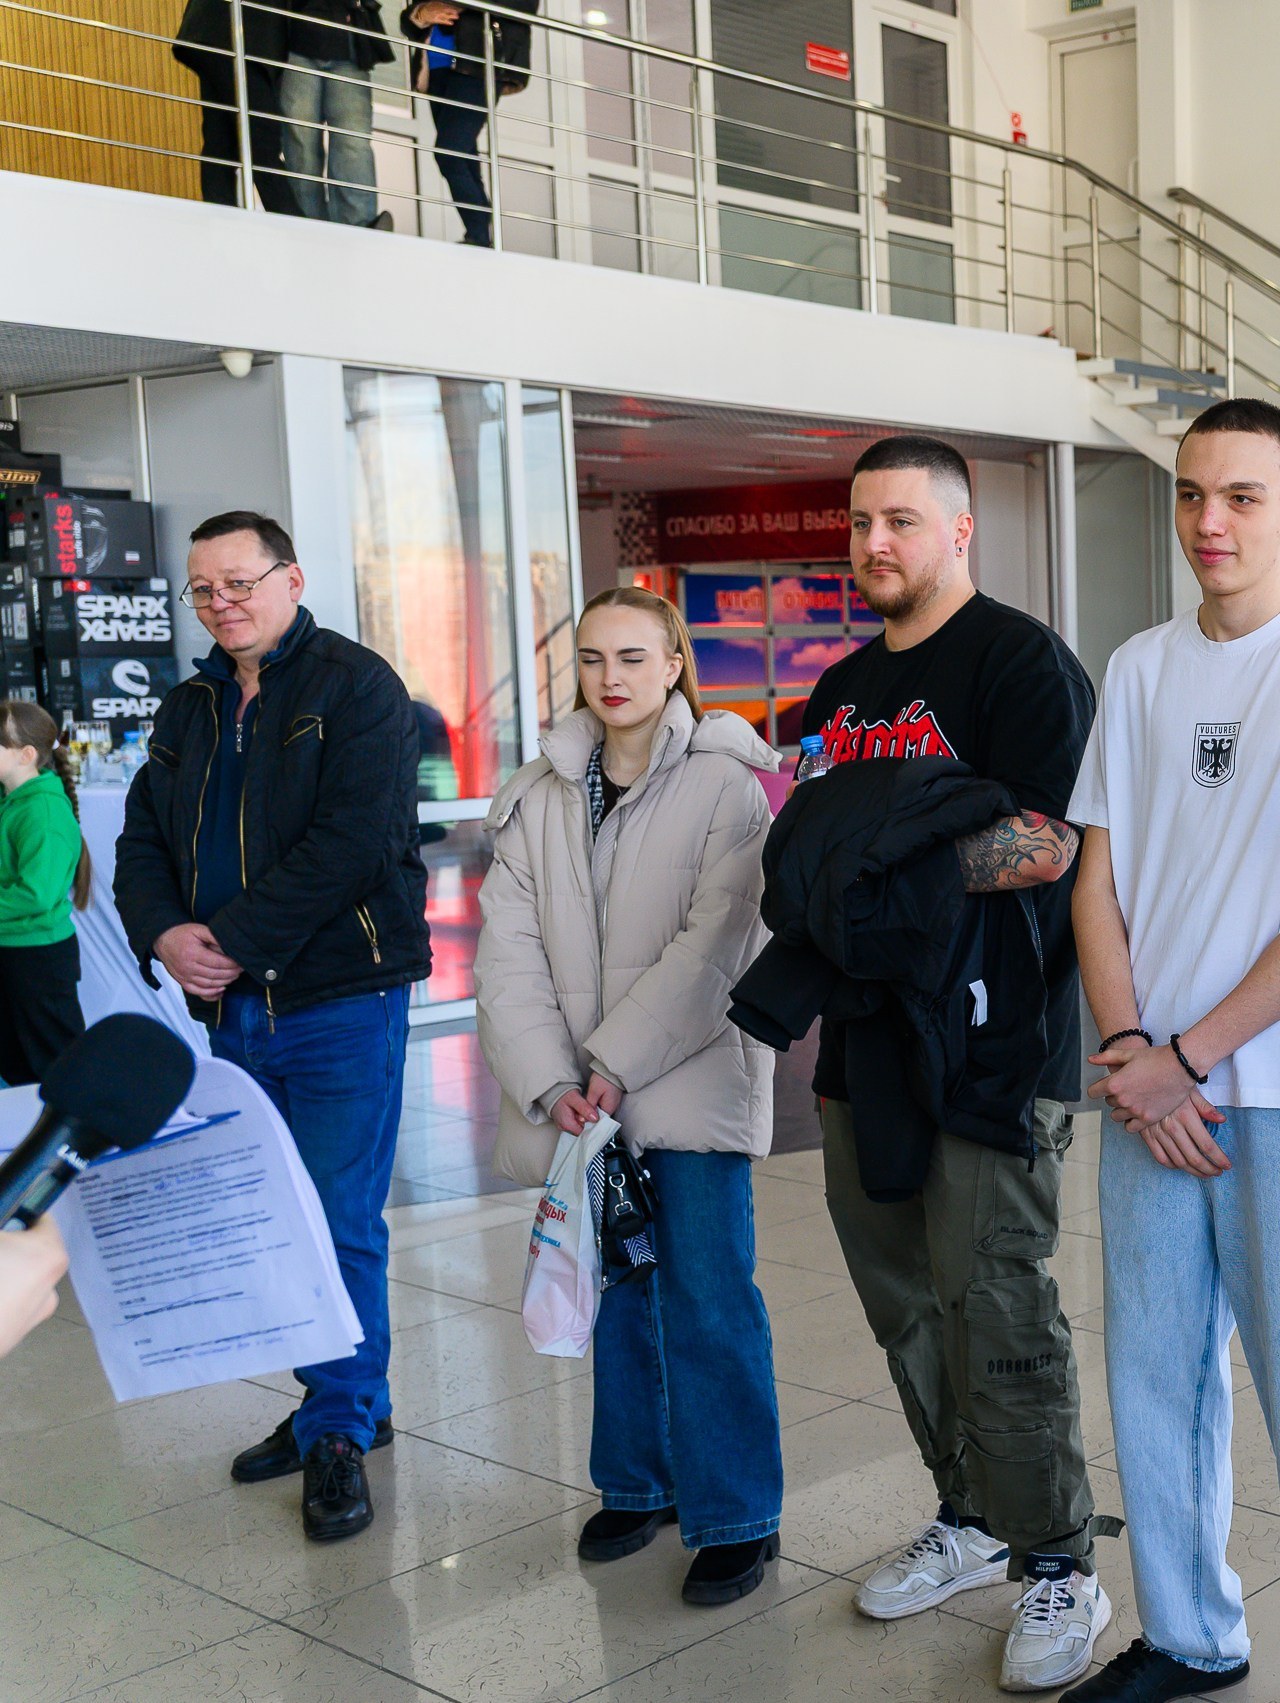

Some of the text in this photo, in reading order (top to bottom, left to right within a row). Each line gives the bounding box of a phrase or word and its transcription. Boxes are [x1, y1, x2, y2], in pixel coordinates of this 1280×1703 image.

[666, 515, 736, 536] СПАСИБО
[739, 514, 760, 534] ЗА
[762, 512, 799, 533] ВАШ
[53, 504, 77, 574] starks
[76, 594, 170, 619] SPARX
[79, 618, 172, 642] SPARX
[92, 696, 162, 718] SPAR
[1201, 725, 1236, 734] VULTURES
